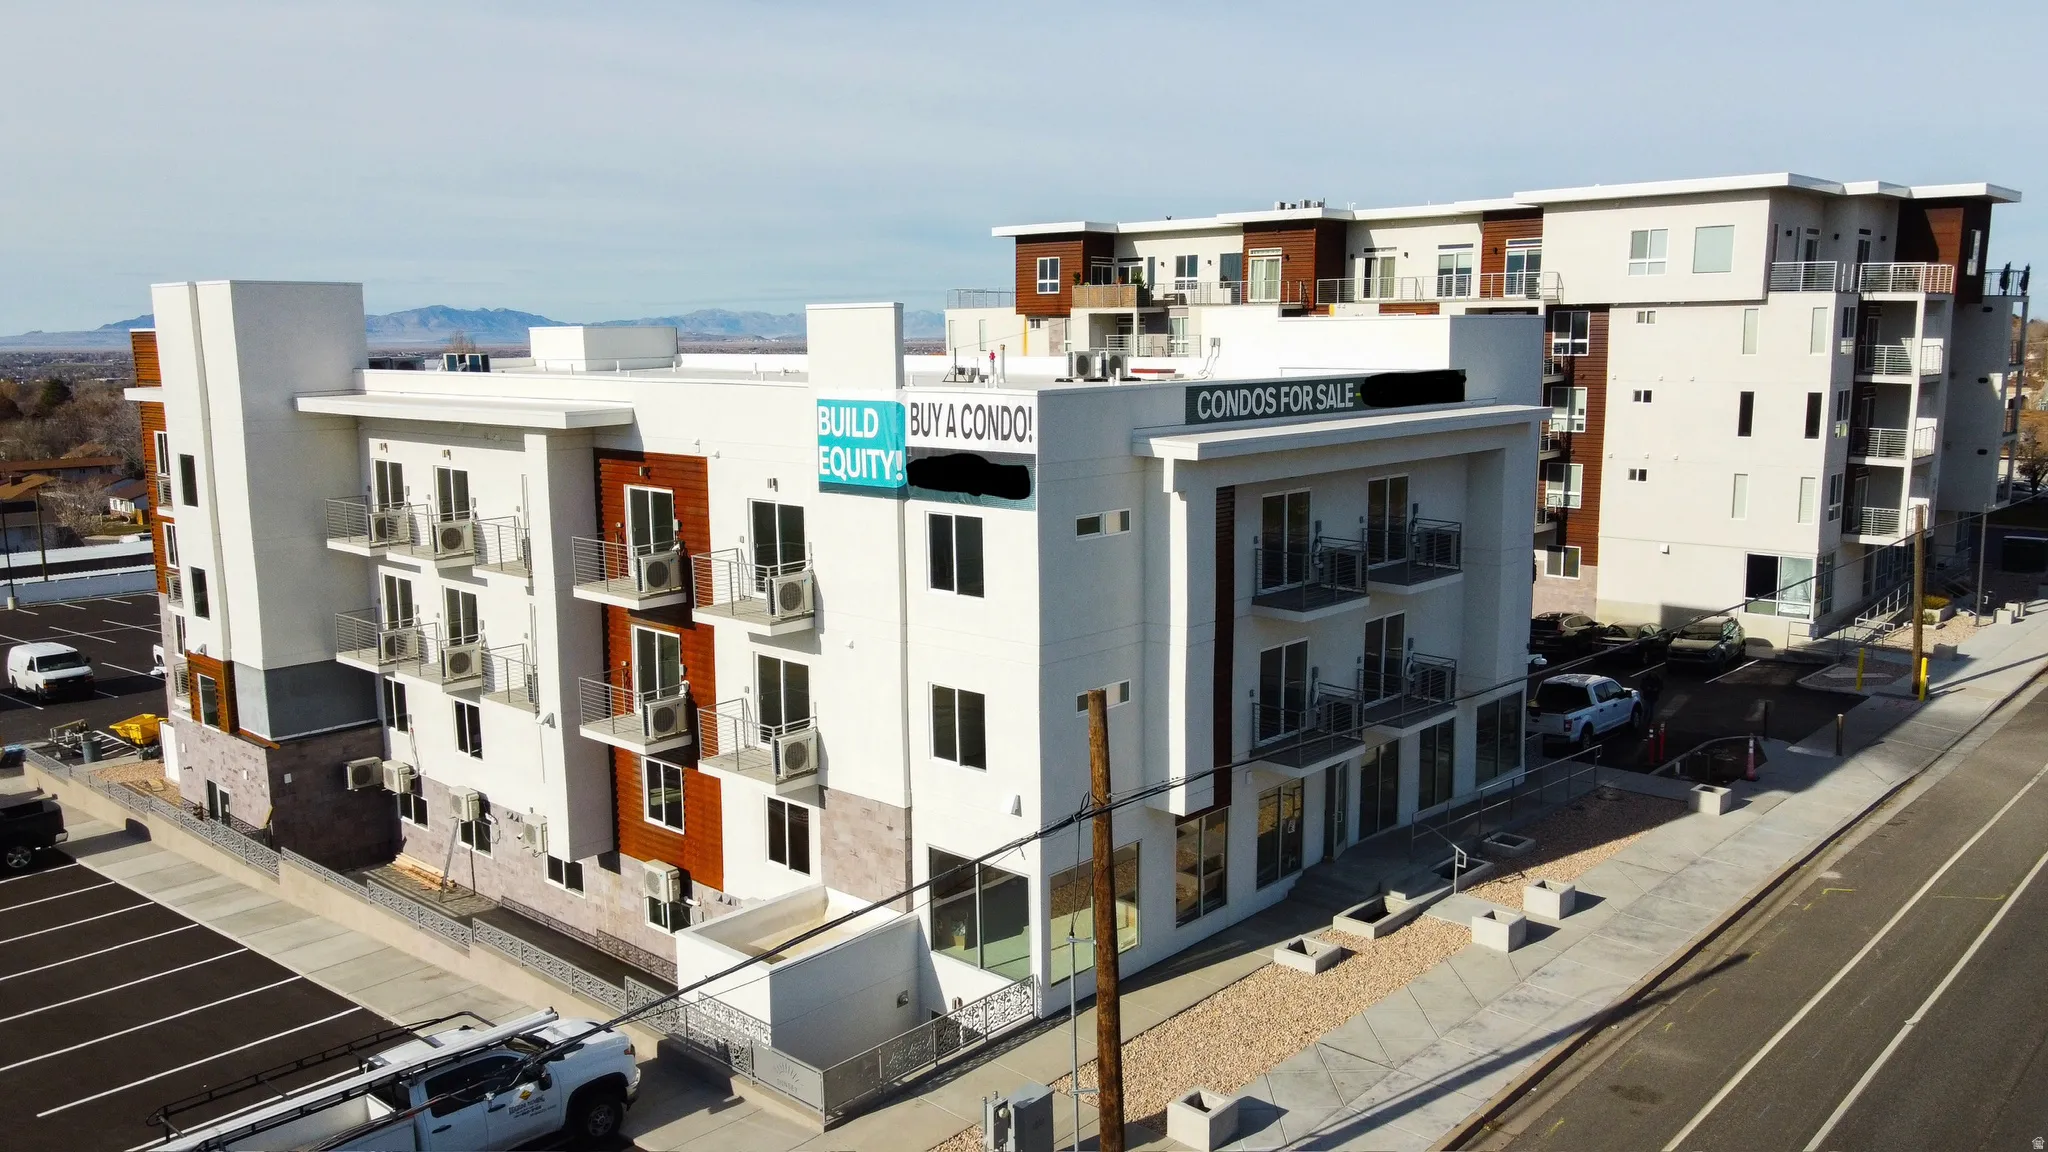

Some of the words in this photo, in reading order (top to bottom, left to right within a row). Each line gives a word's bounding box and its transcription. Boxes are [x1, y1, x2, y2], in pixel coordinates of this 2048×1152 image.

[1198, 387, 1276, 420] CONDOS
[1280, 383, 1313, 413] FOR
[1316, 382, 1354, 409] SALE
[818, 406, 879, 438] BUILD
[910, 402, 943, 437] BUY
[945, 403, 957, 438] A
[961, 404, 1033, 443] CONDO!
[819, 446, 904, 481] EQUITY!
